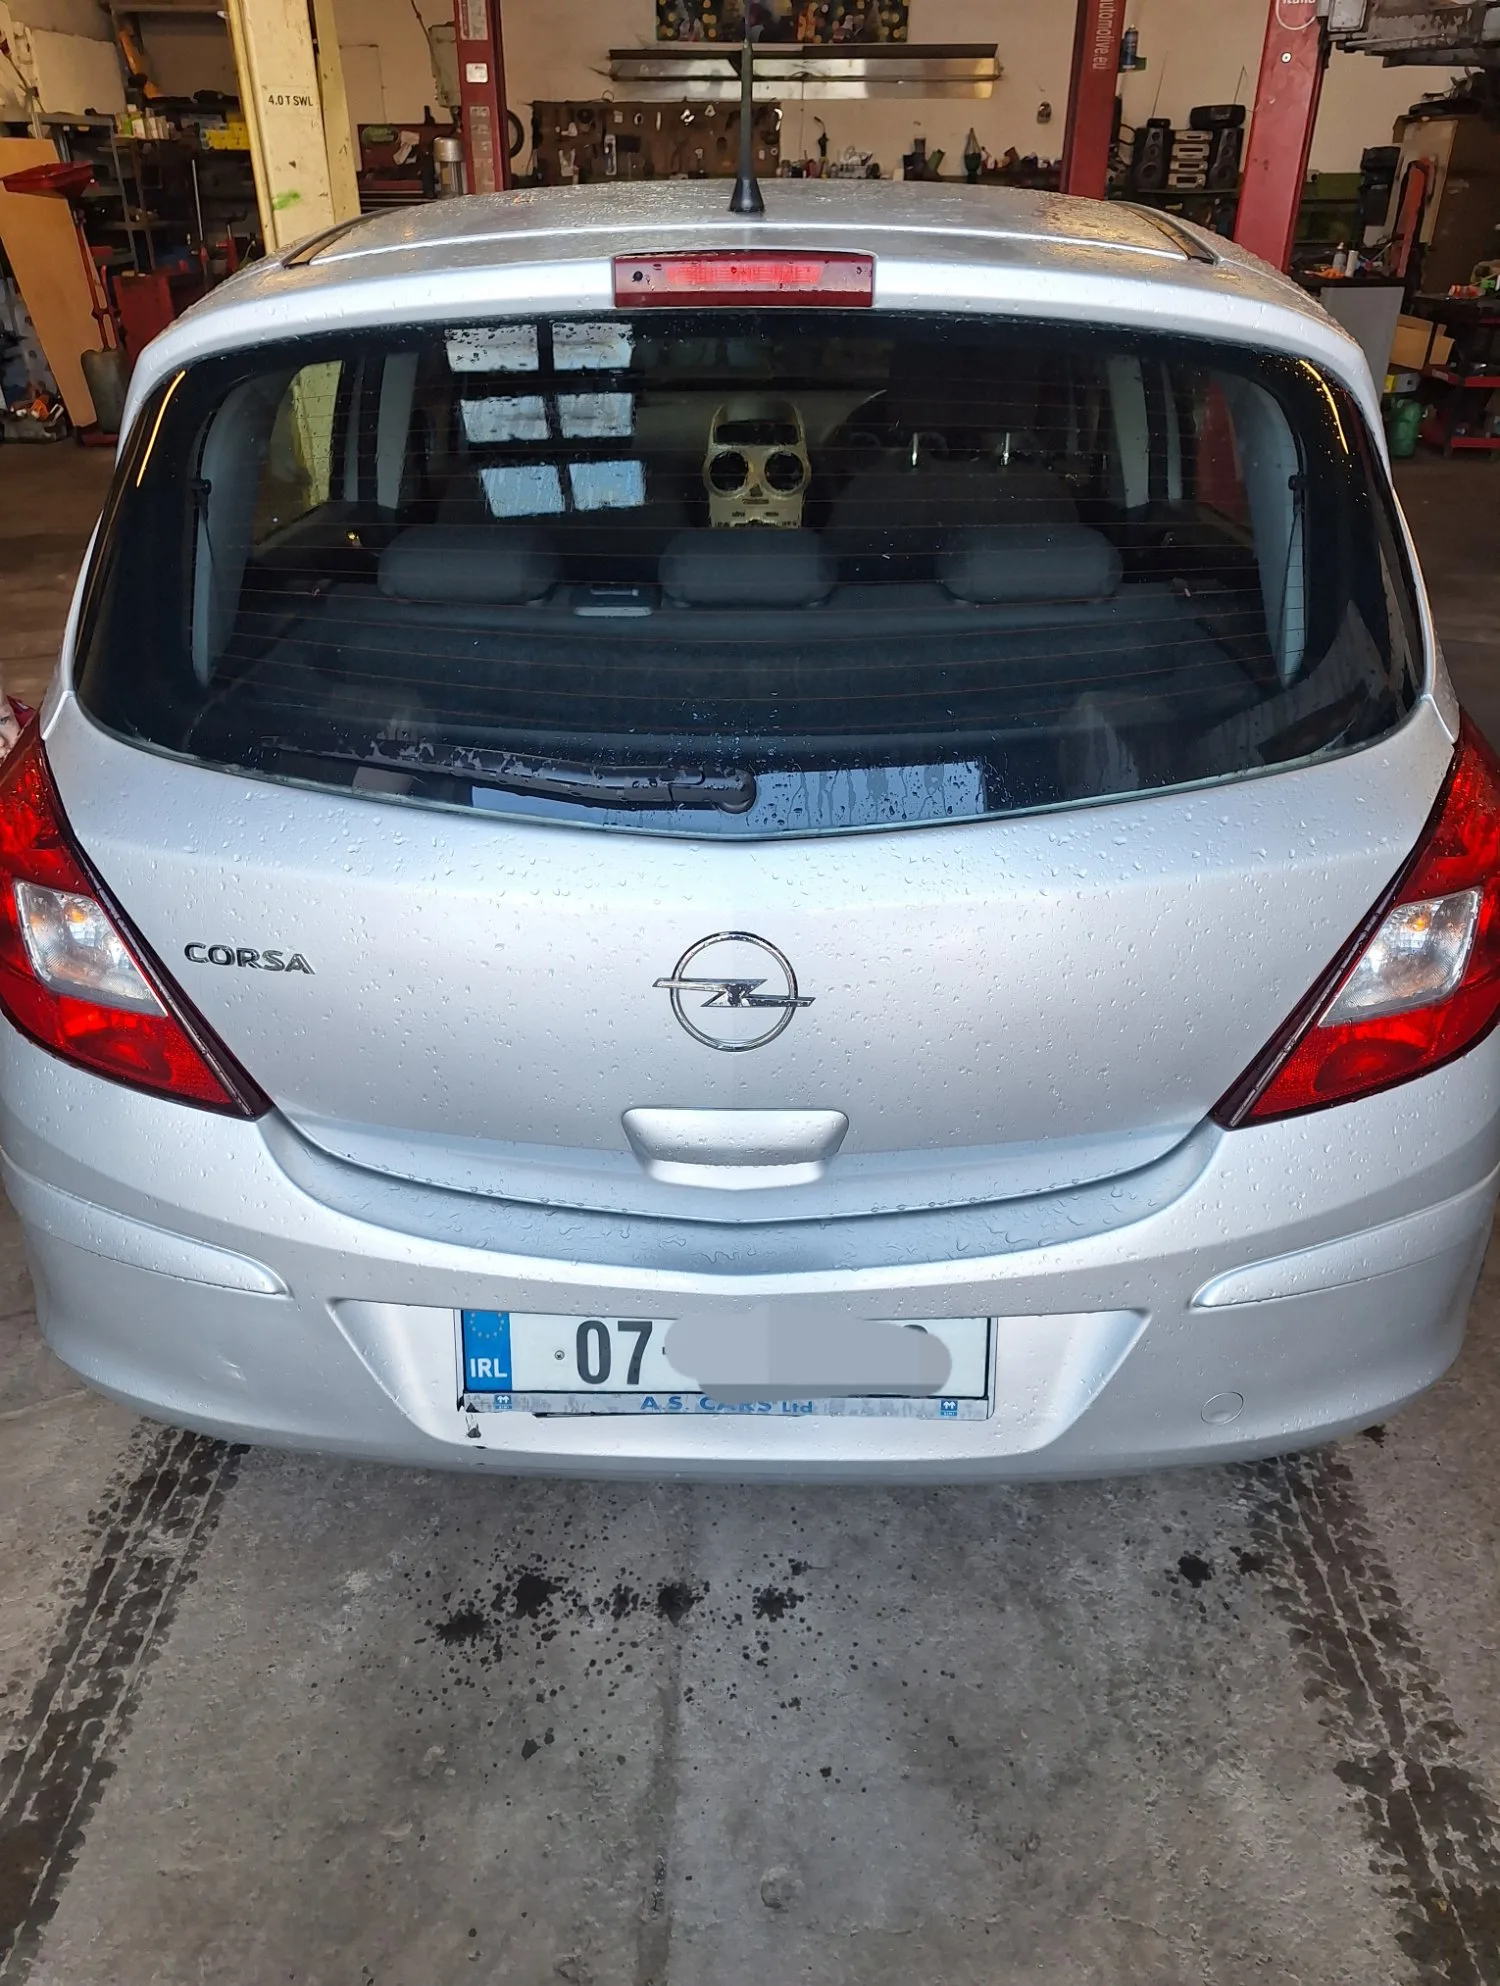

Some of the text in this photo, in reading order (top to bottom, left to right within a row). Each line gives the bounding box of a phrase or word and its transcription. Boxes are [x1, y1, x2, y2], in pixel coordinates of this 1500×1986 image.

[268, 94, 284, 106] 4.0
[292, 95, 314, 107] SWL
[184, 941, 316, 975] CORSA
[469, 1357, 508, 1379] IRL
[639, 1395, 690, 1411] A.S.
[781, 1400, 813, 1414] Ltd
